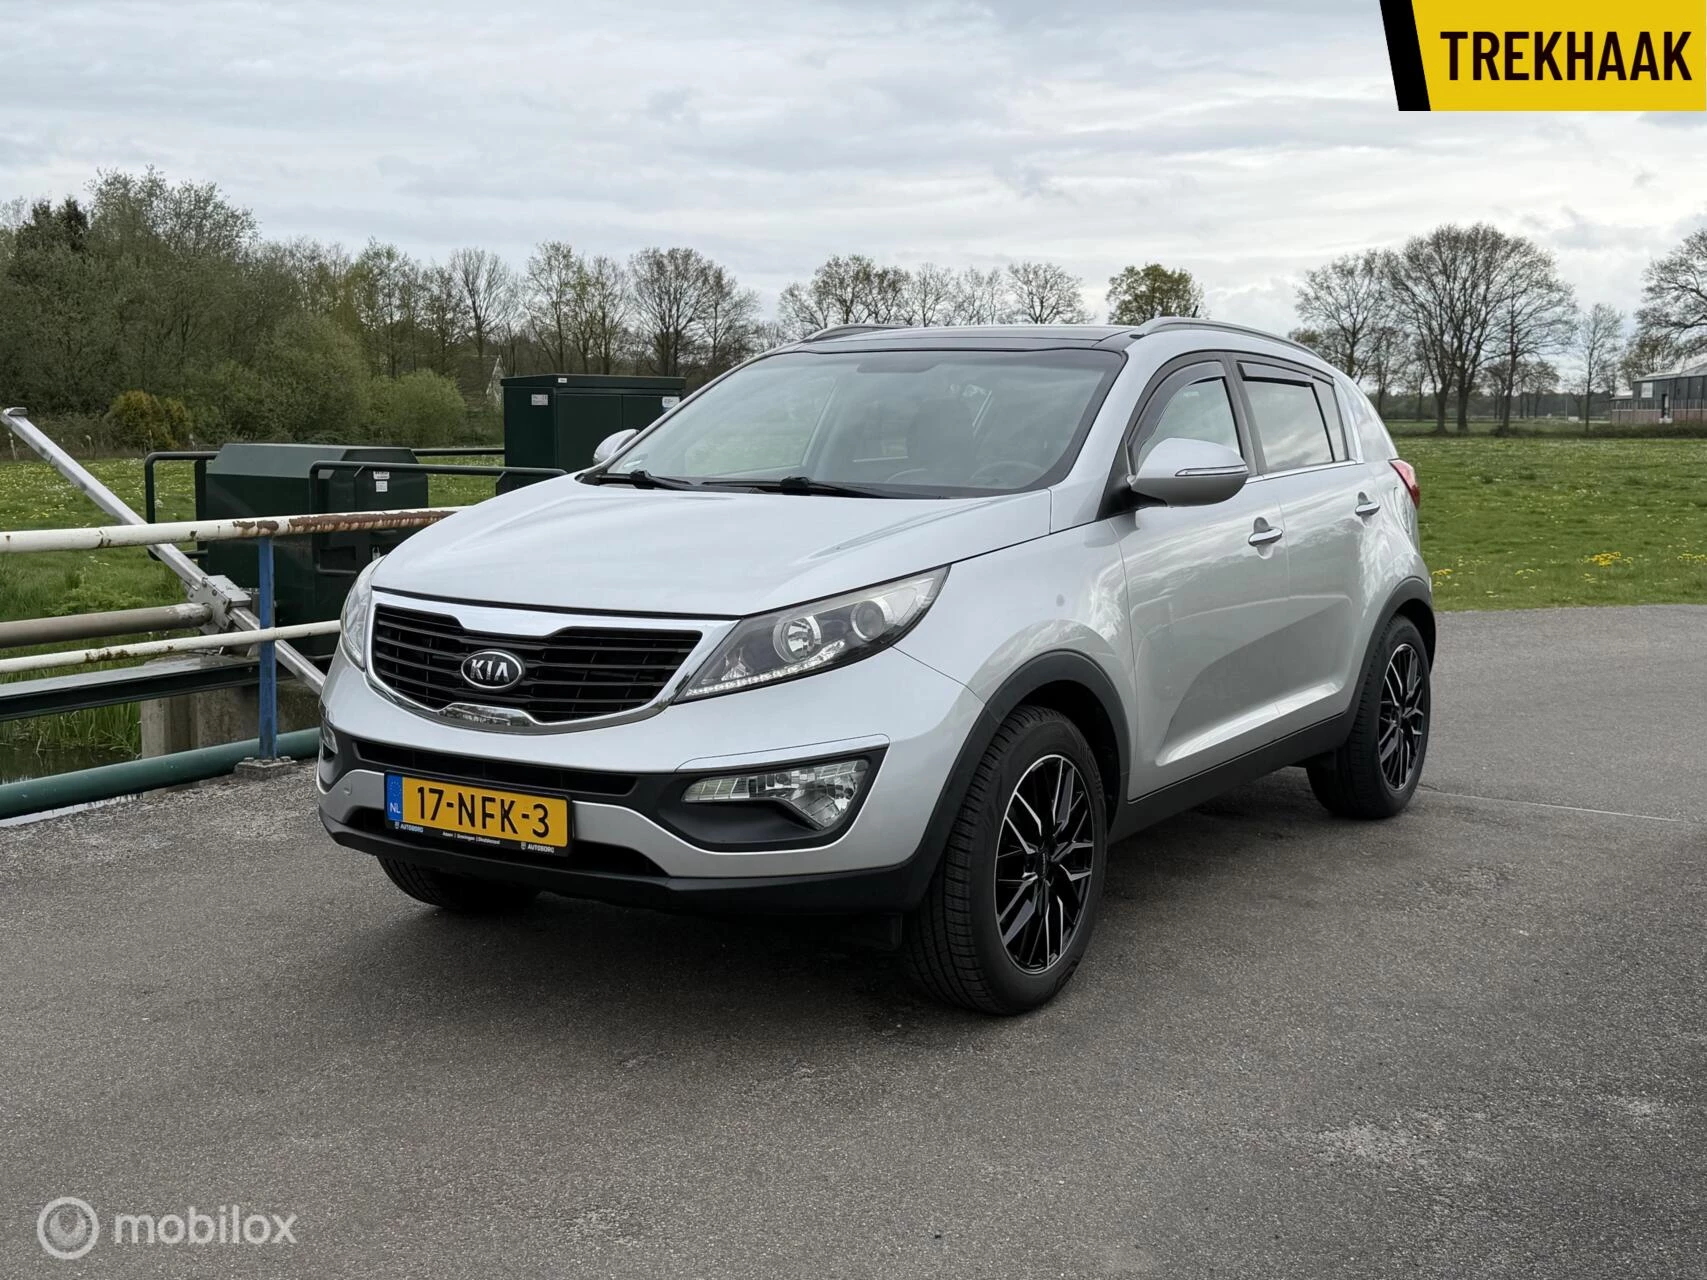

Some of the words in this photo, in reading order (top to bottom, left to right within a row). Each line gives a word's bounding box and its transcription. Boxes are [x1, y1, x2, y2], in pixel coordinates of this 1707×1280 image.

[470, 658, 511, 682] KIA
[390, 802, 400, 813] NL
[417, 786, 549, 838] 17-NFK-3
